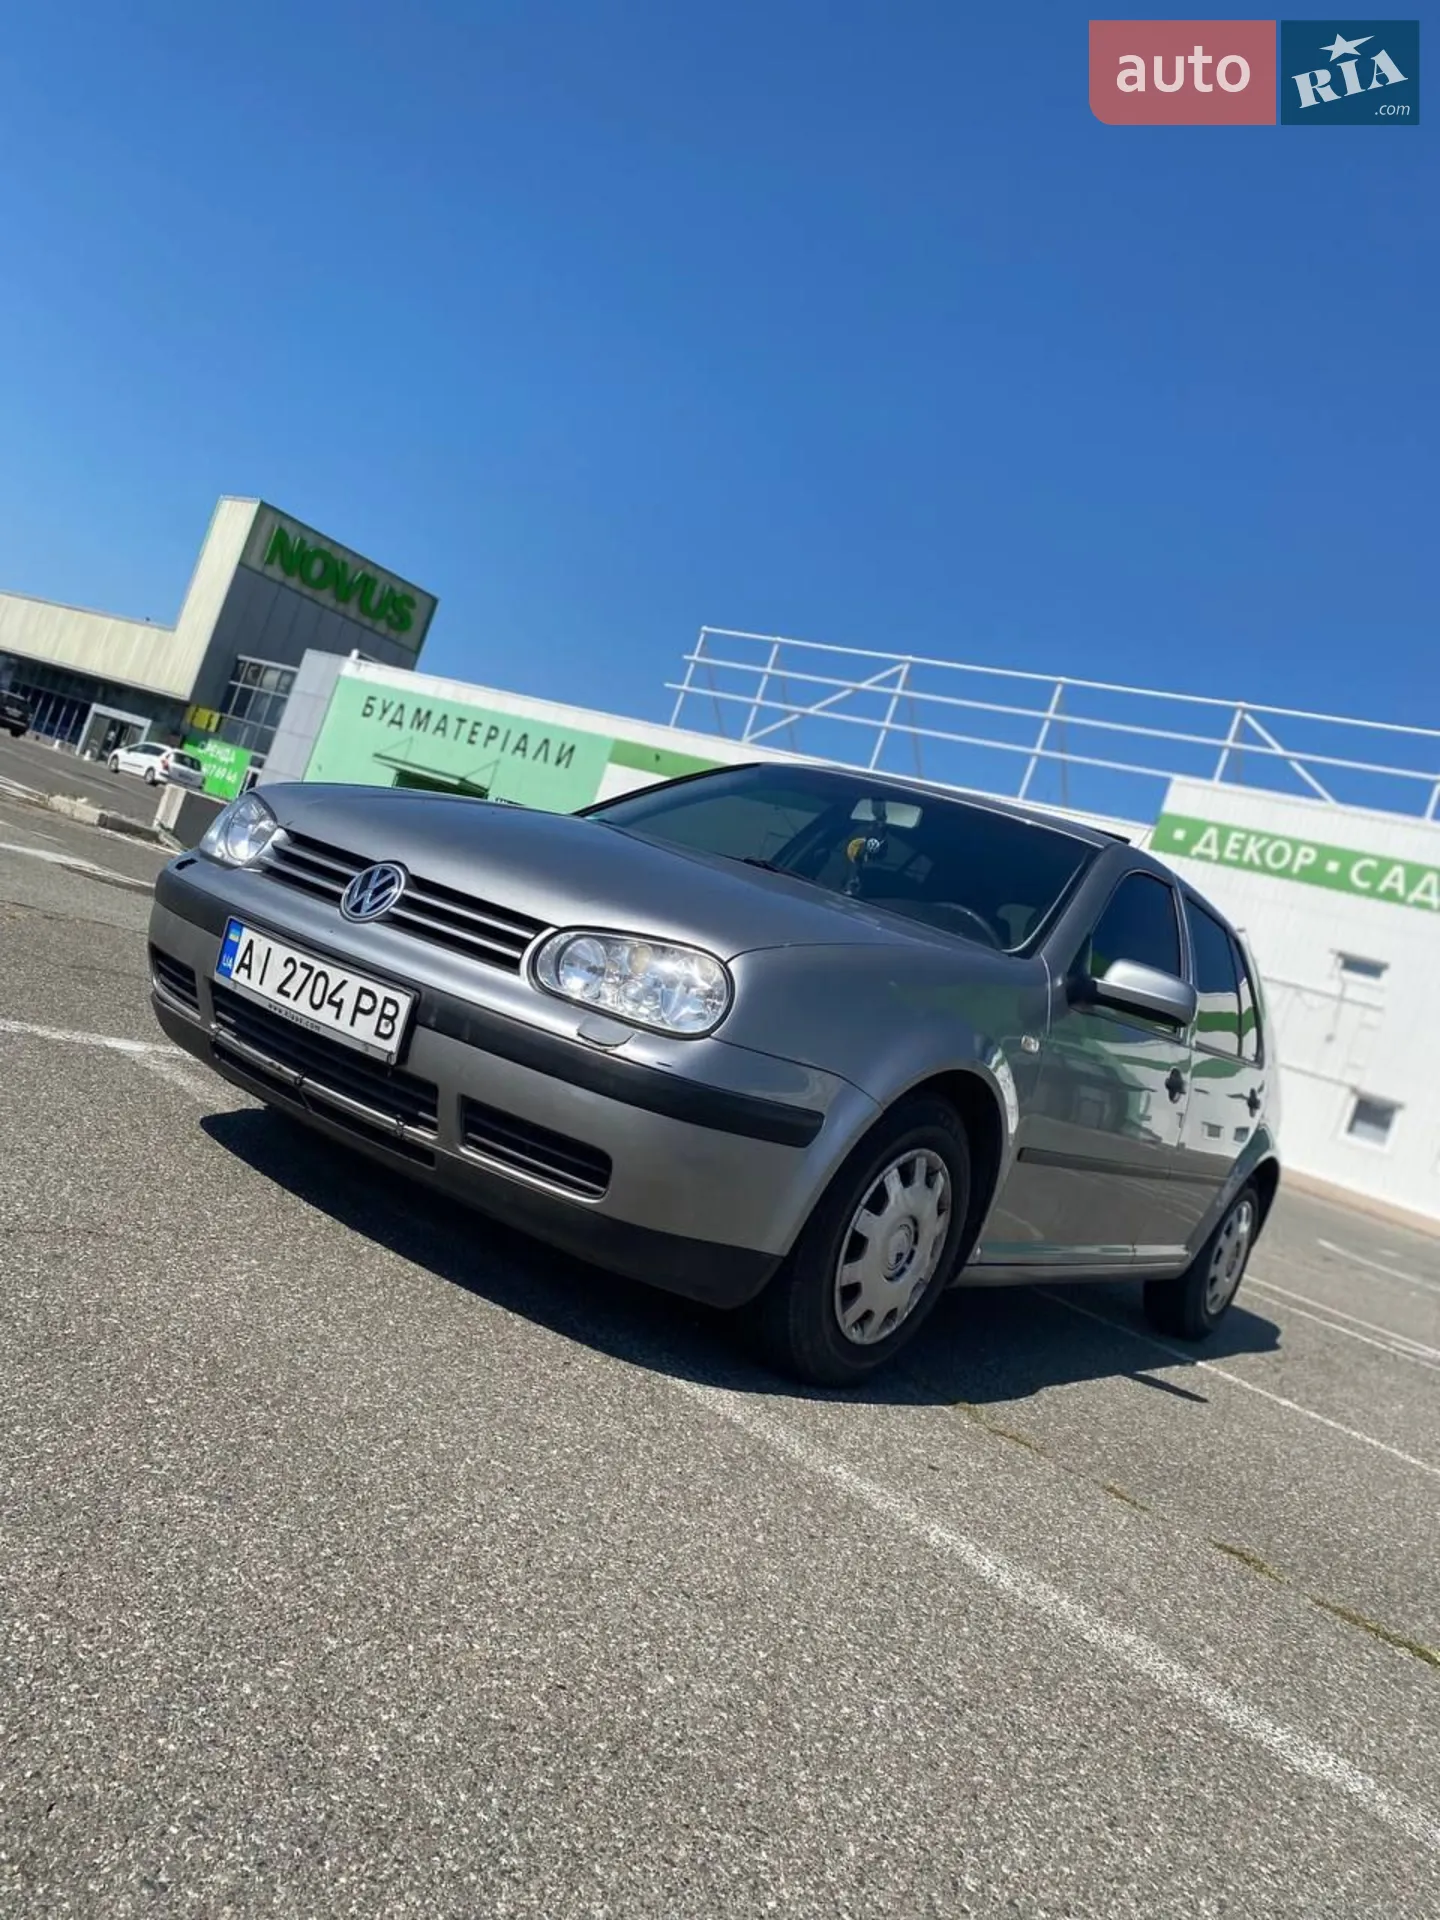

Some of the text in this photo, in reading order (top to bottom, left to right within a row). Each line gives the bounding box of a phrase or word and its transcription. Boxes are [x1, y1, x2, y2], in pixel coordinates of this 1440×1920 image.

[264, 526, 417, 633] NOVUS
[361, 695, 576, 768] БУДМАТЕРІАЛИ
[1190, 827, 1317, 874] ДЕКОР
[235, 938, 400, 1040] AI 2704 PB
